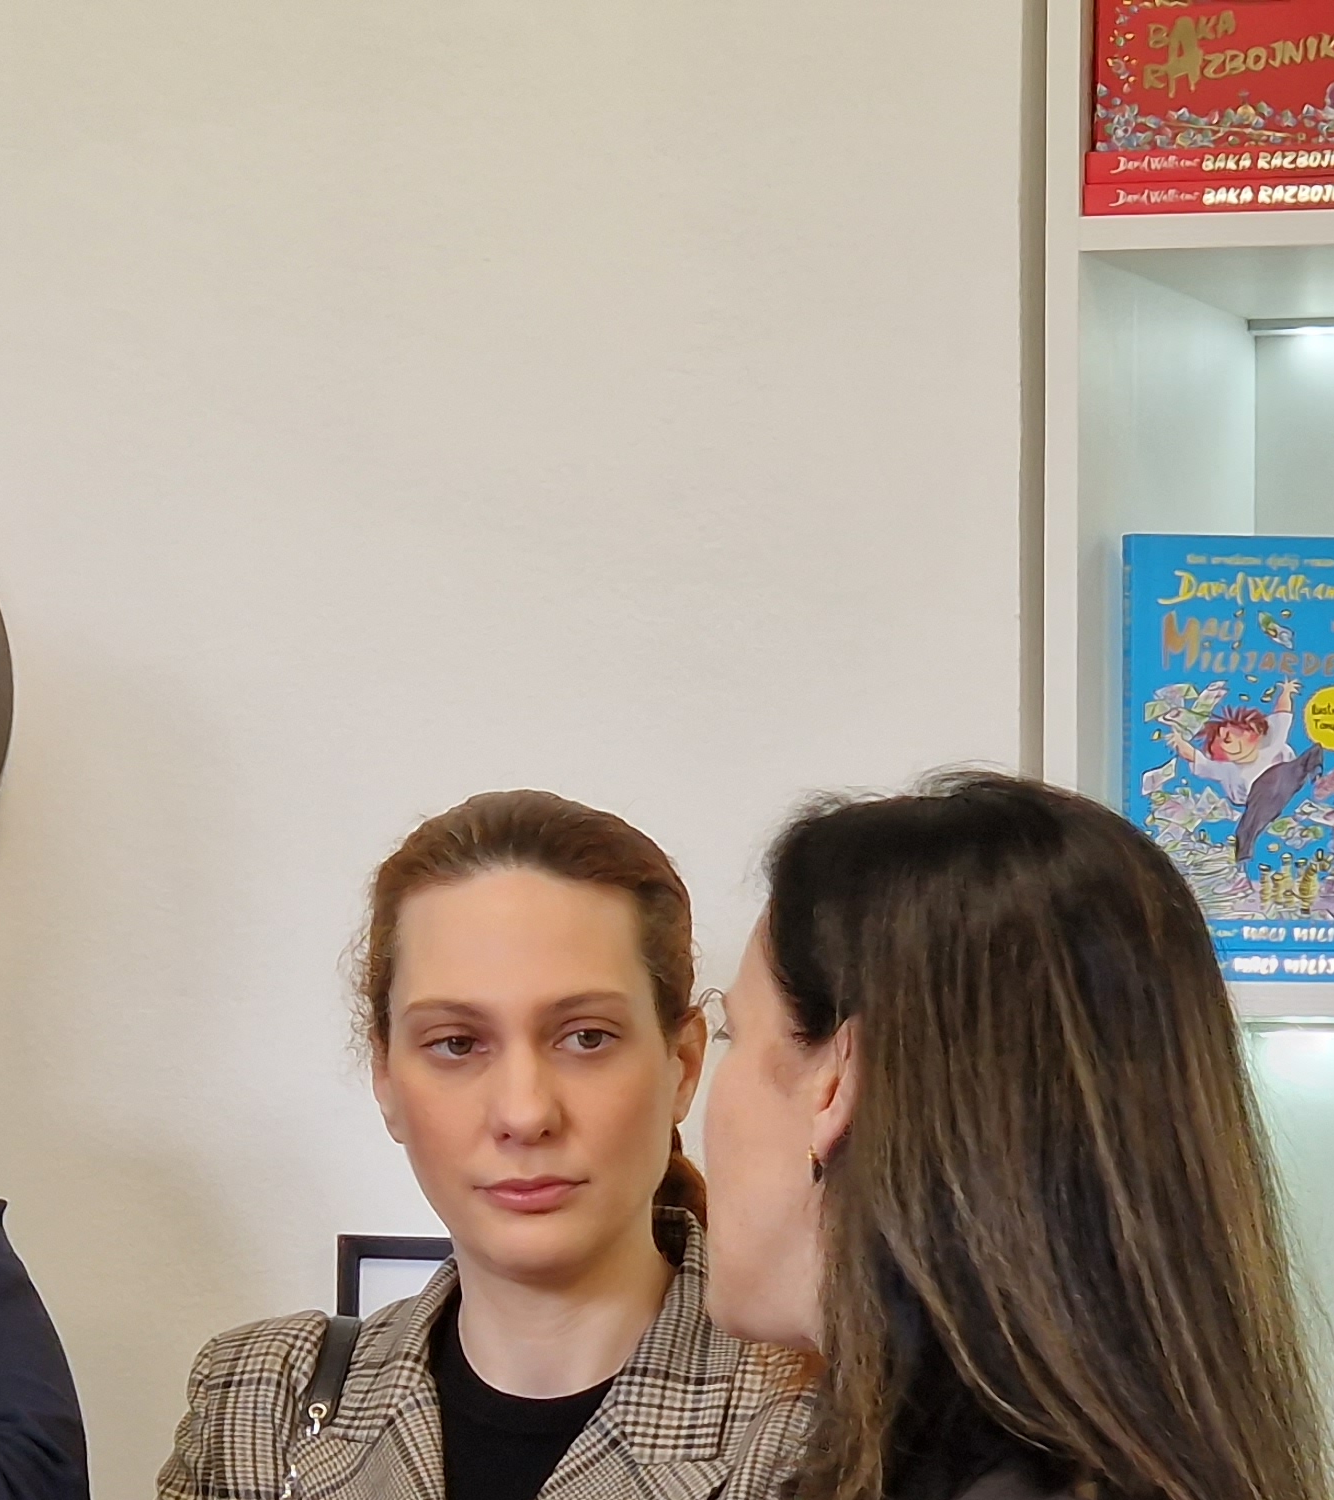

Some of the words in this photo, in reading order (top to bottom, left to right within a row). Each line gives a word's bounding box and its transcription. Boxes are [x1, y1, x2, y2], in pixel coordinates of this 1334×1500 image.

[1202, 153, 1251, 171] BAKA
[1202, 187, 1253, 205] BAKA
[1157, 570, 1245, 605] David
